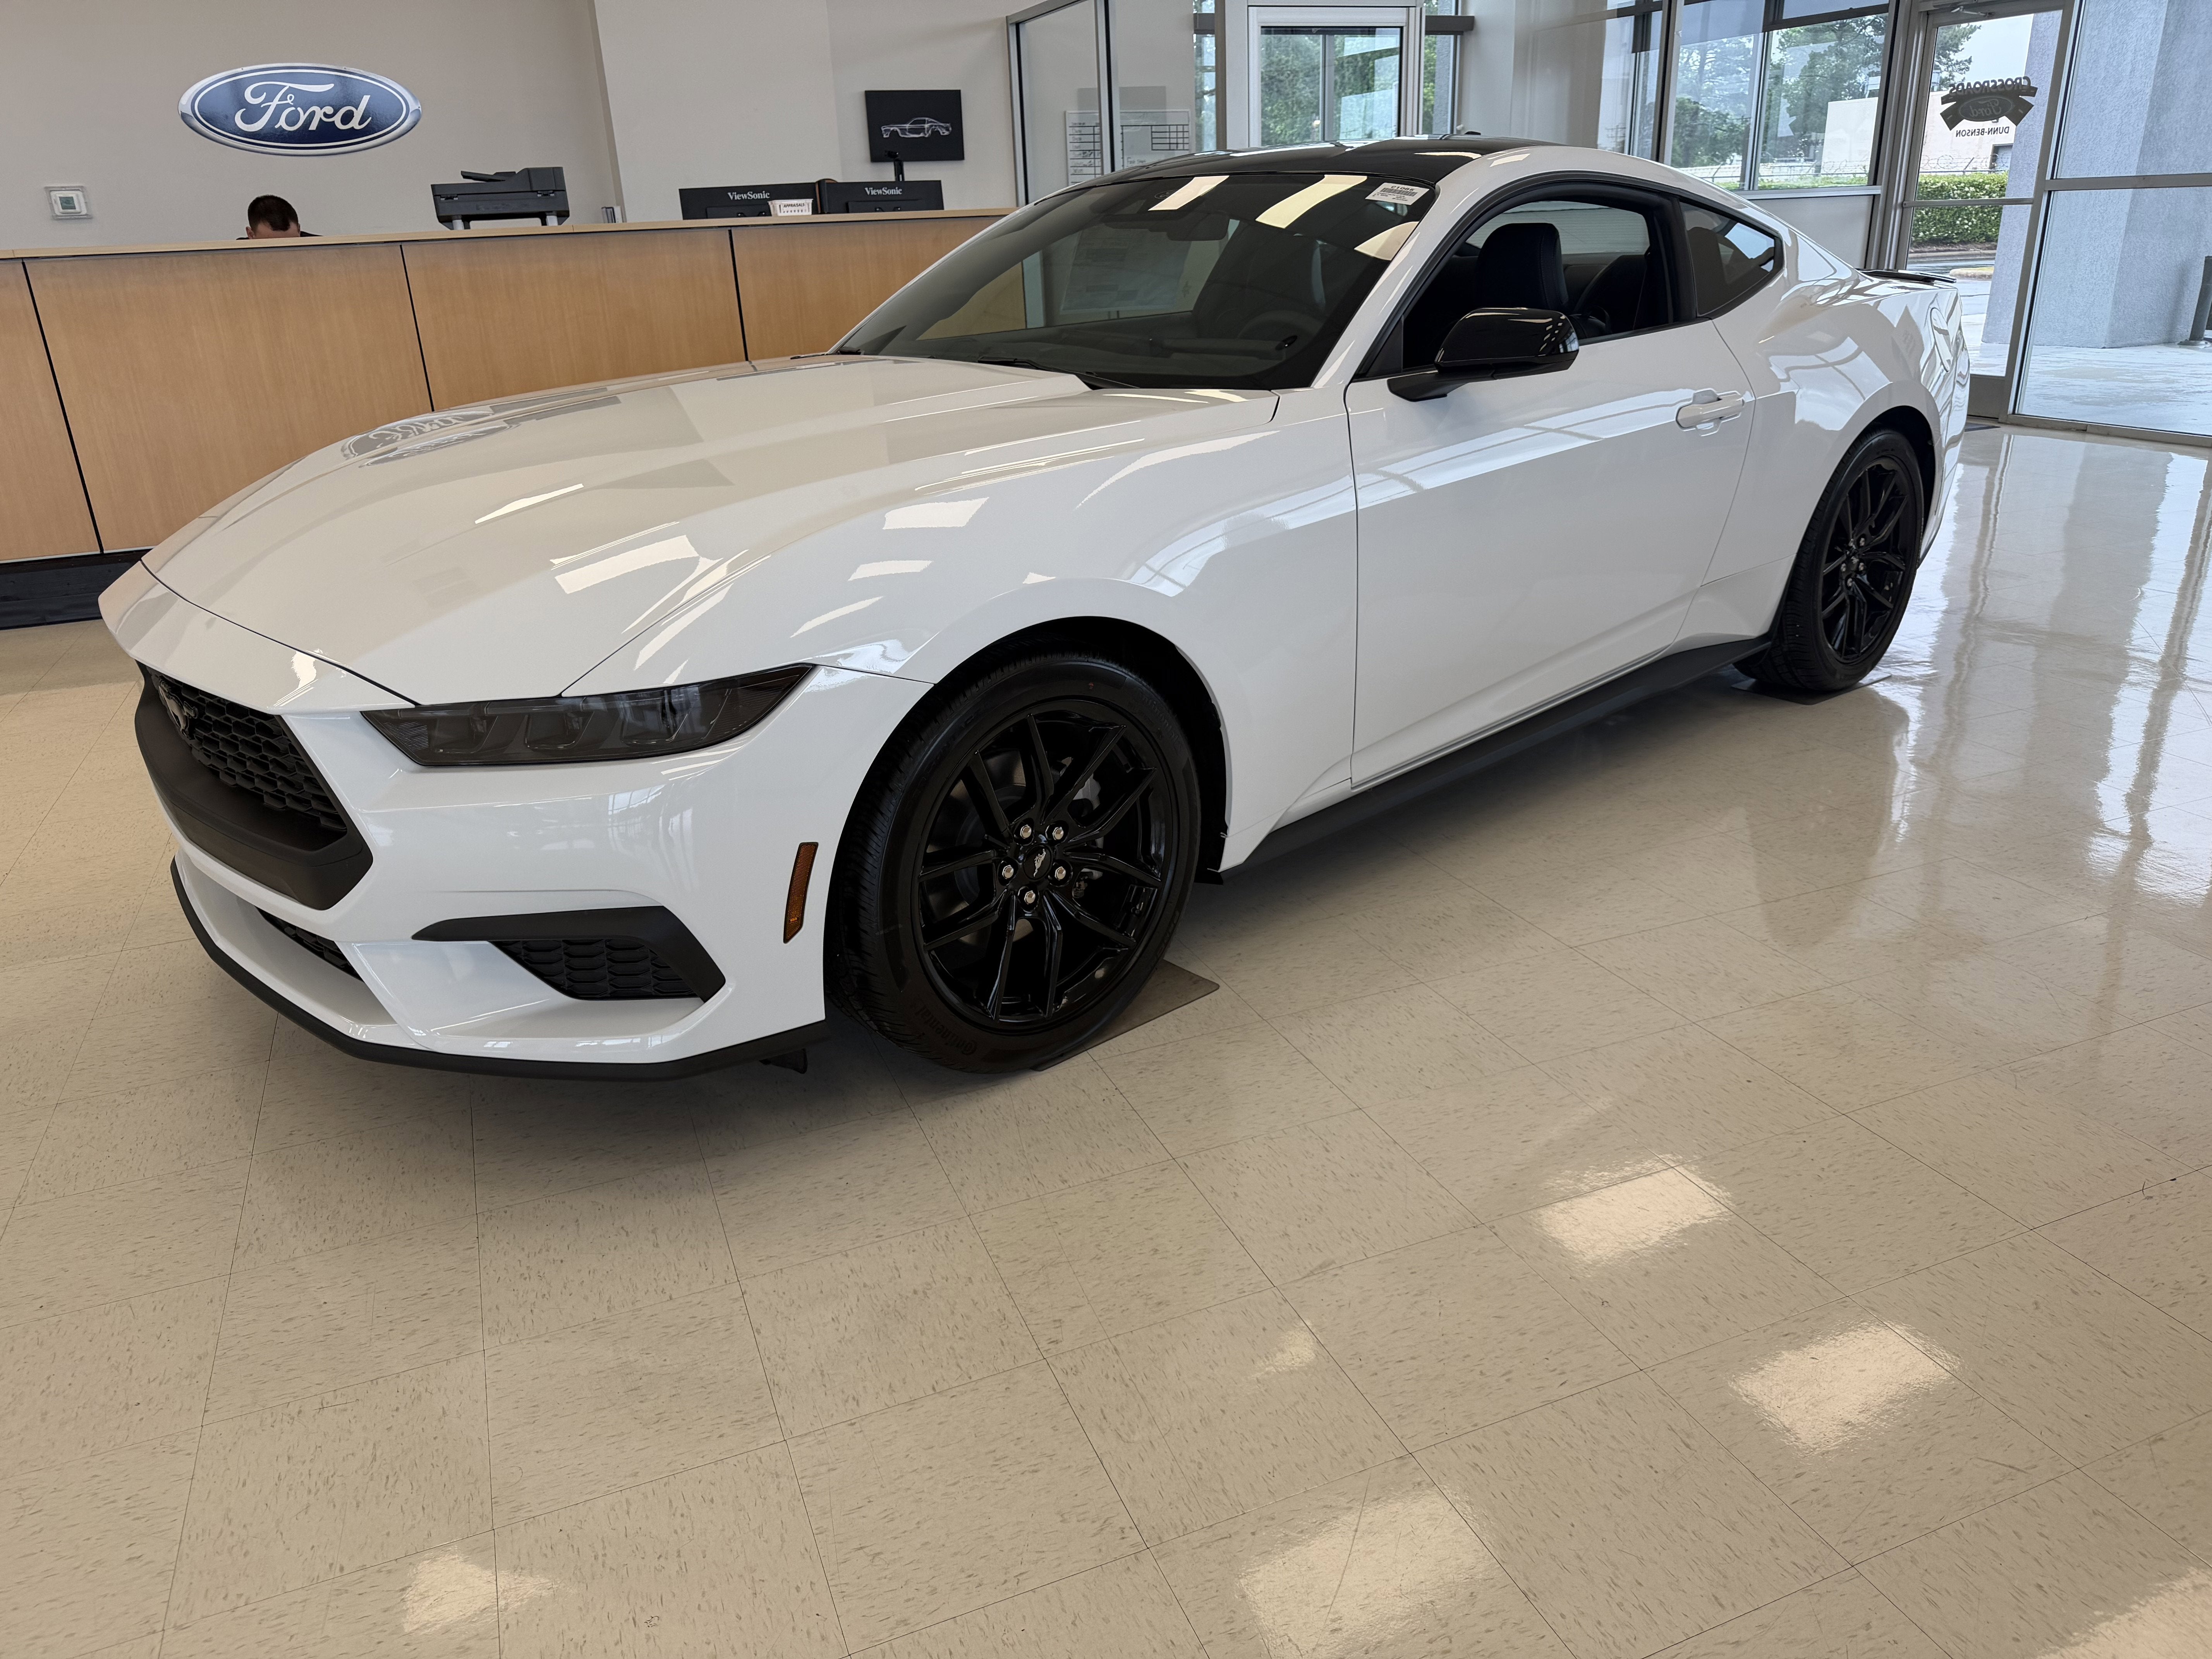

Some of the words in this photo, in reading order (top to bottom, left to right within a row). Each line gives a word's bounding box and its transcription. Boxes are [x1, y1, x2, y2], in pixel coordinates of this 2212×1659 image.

[234, 81, 372, 132] Ford
[727, 191, 770, 200] ViewSonic
[864, 187, 903, 196] ViewSonic
[914, 1005, 977, 1055] Continental
